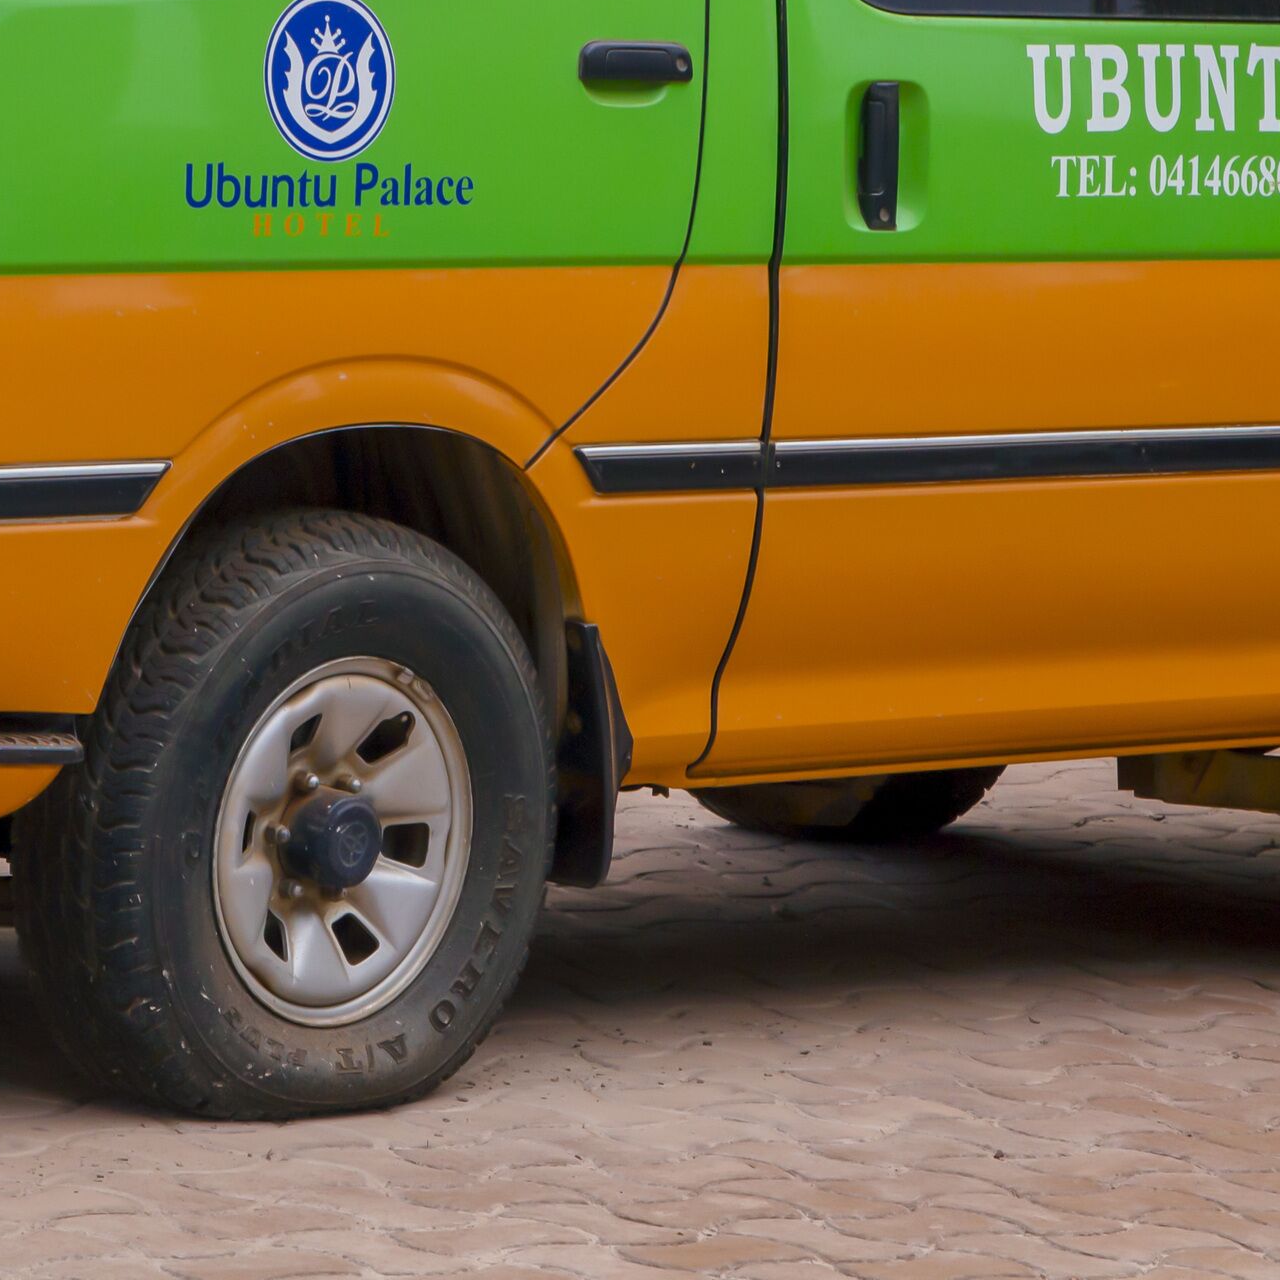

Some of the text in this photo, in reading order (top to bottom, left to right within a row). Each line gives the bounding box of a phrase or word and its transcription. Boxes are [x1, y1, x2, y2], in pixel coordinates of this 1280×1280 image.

[184, 161, 475, 209] Ubuntu Palace
[1050, 154, 1137, 198] TEL:
[252, 213, 391, 238] HOTEL
